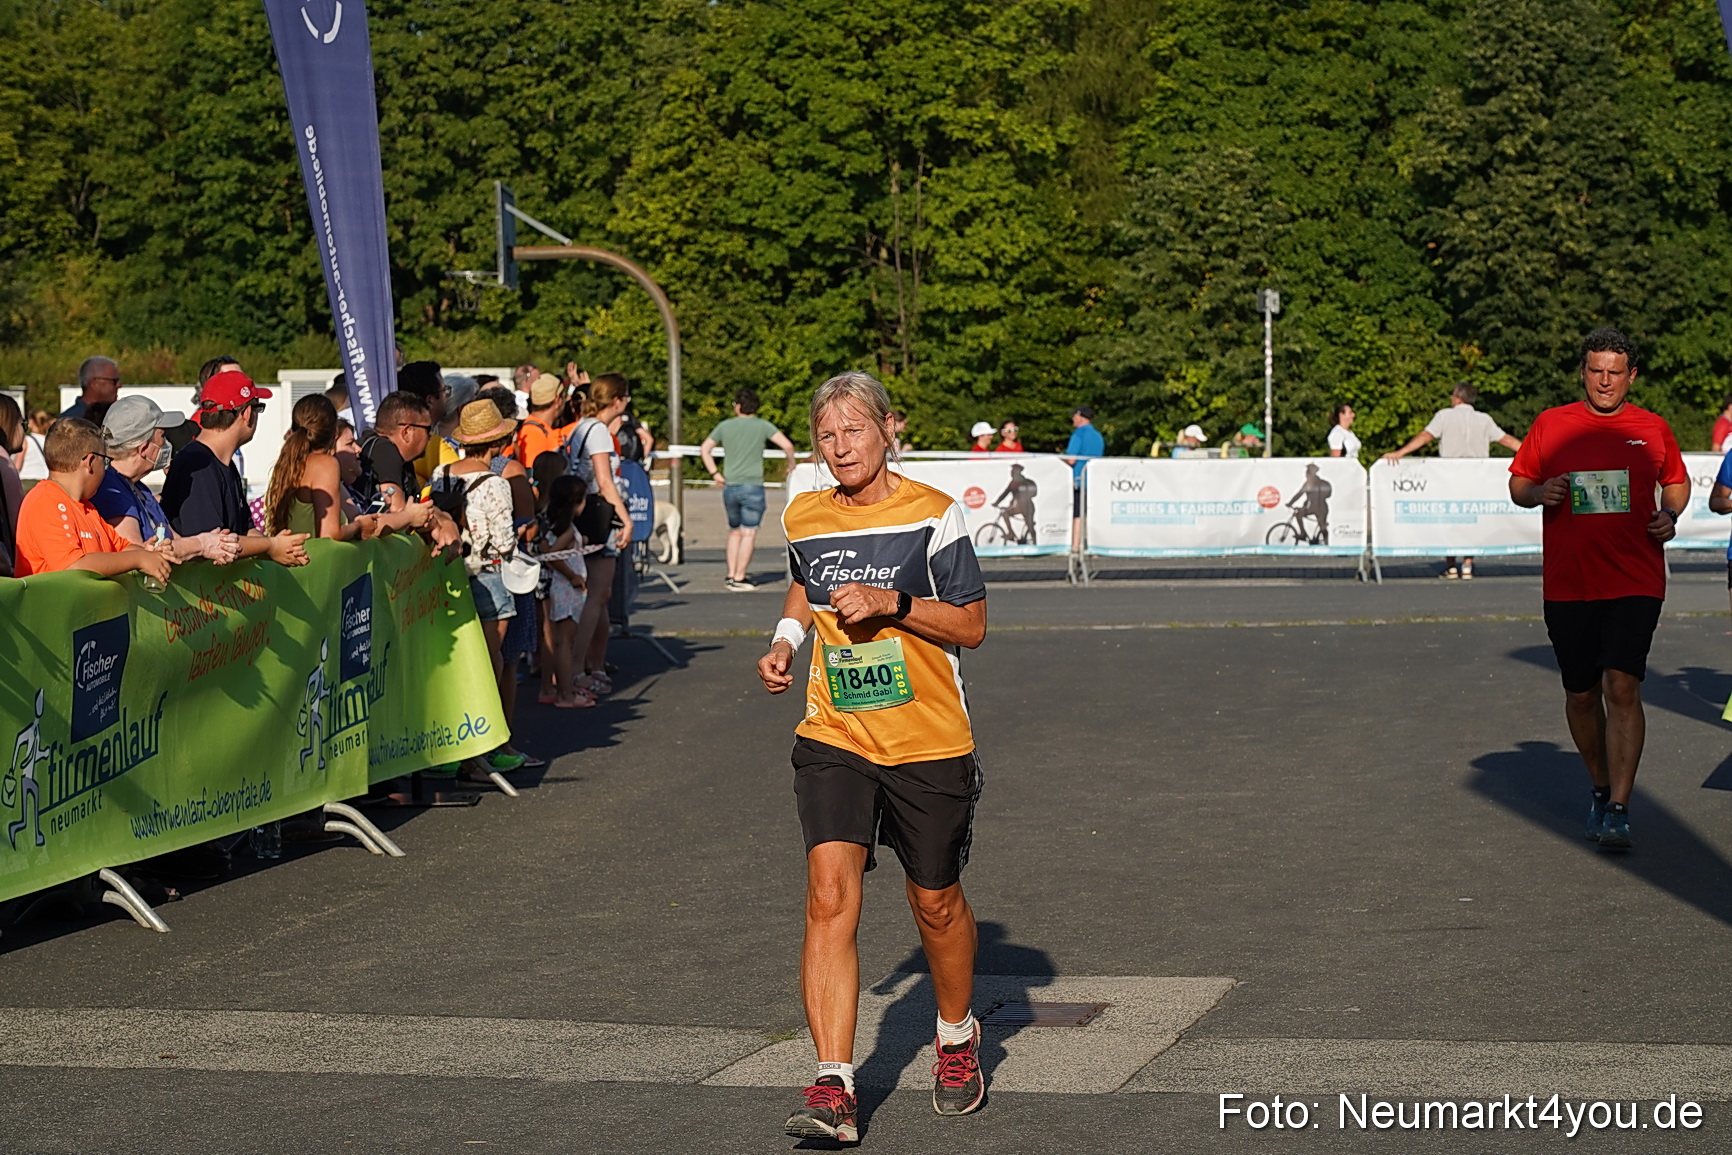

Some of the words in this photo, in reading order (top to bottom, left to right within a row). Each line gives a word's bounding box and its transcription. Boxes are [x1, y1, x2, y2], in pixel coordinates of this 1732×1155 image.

[1110, 480, 1146, 492] NOW
[1393, 480, 1427, 492] NOW
[1620, 487, 1628, 506] 2022
[820, 564, 900, 581] Fischer
[215, 577, 266, 617] Firmen
[345, 606, 371, 630] Fischer
[83, 653, 118, 682] Fischer
[188, 632, 229, 683] laufen
[86, 672, 112, 692] AUTOMOBILE
[830, 676, 840, 698] RUN
[837, 664, 893, 690] 1840
[893, 665, 909, 695] 2022
[843, 690, 871, 700] Schmid
[872, 687, 893, 698] Gabi
[48, 690, 168, 805] firmenlauf
[50, 789, 103, 836] neumarkt
[129, 771, 273, 840] www.firmenlauf-oberpfalz.de
